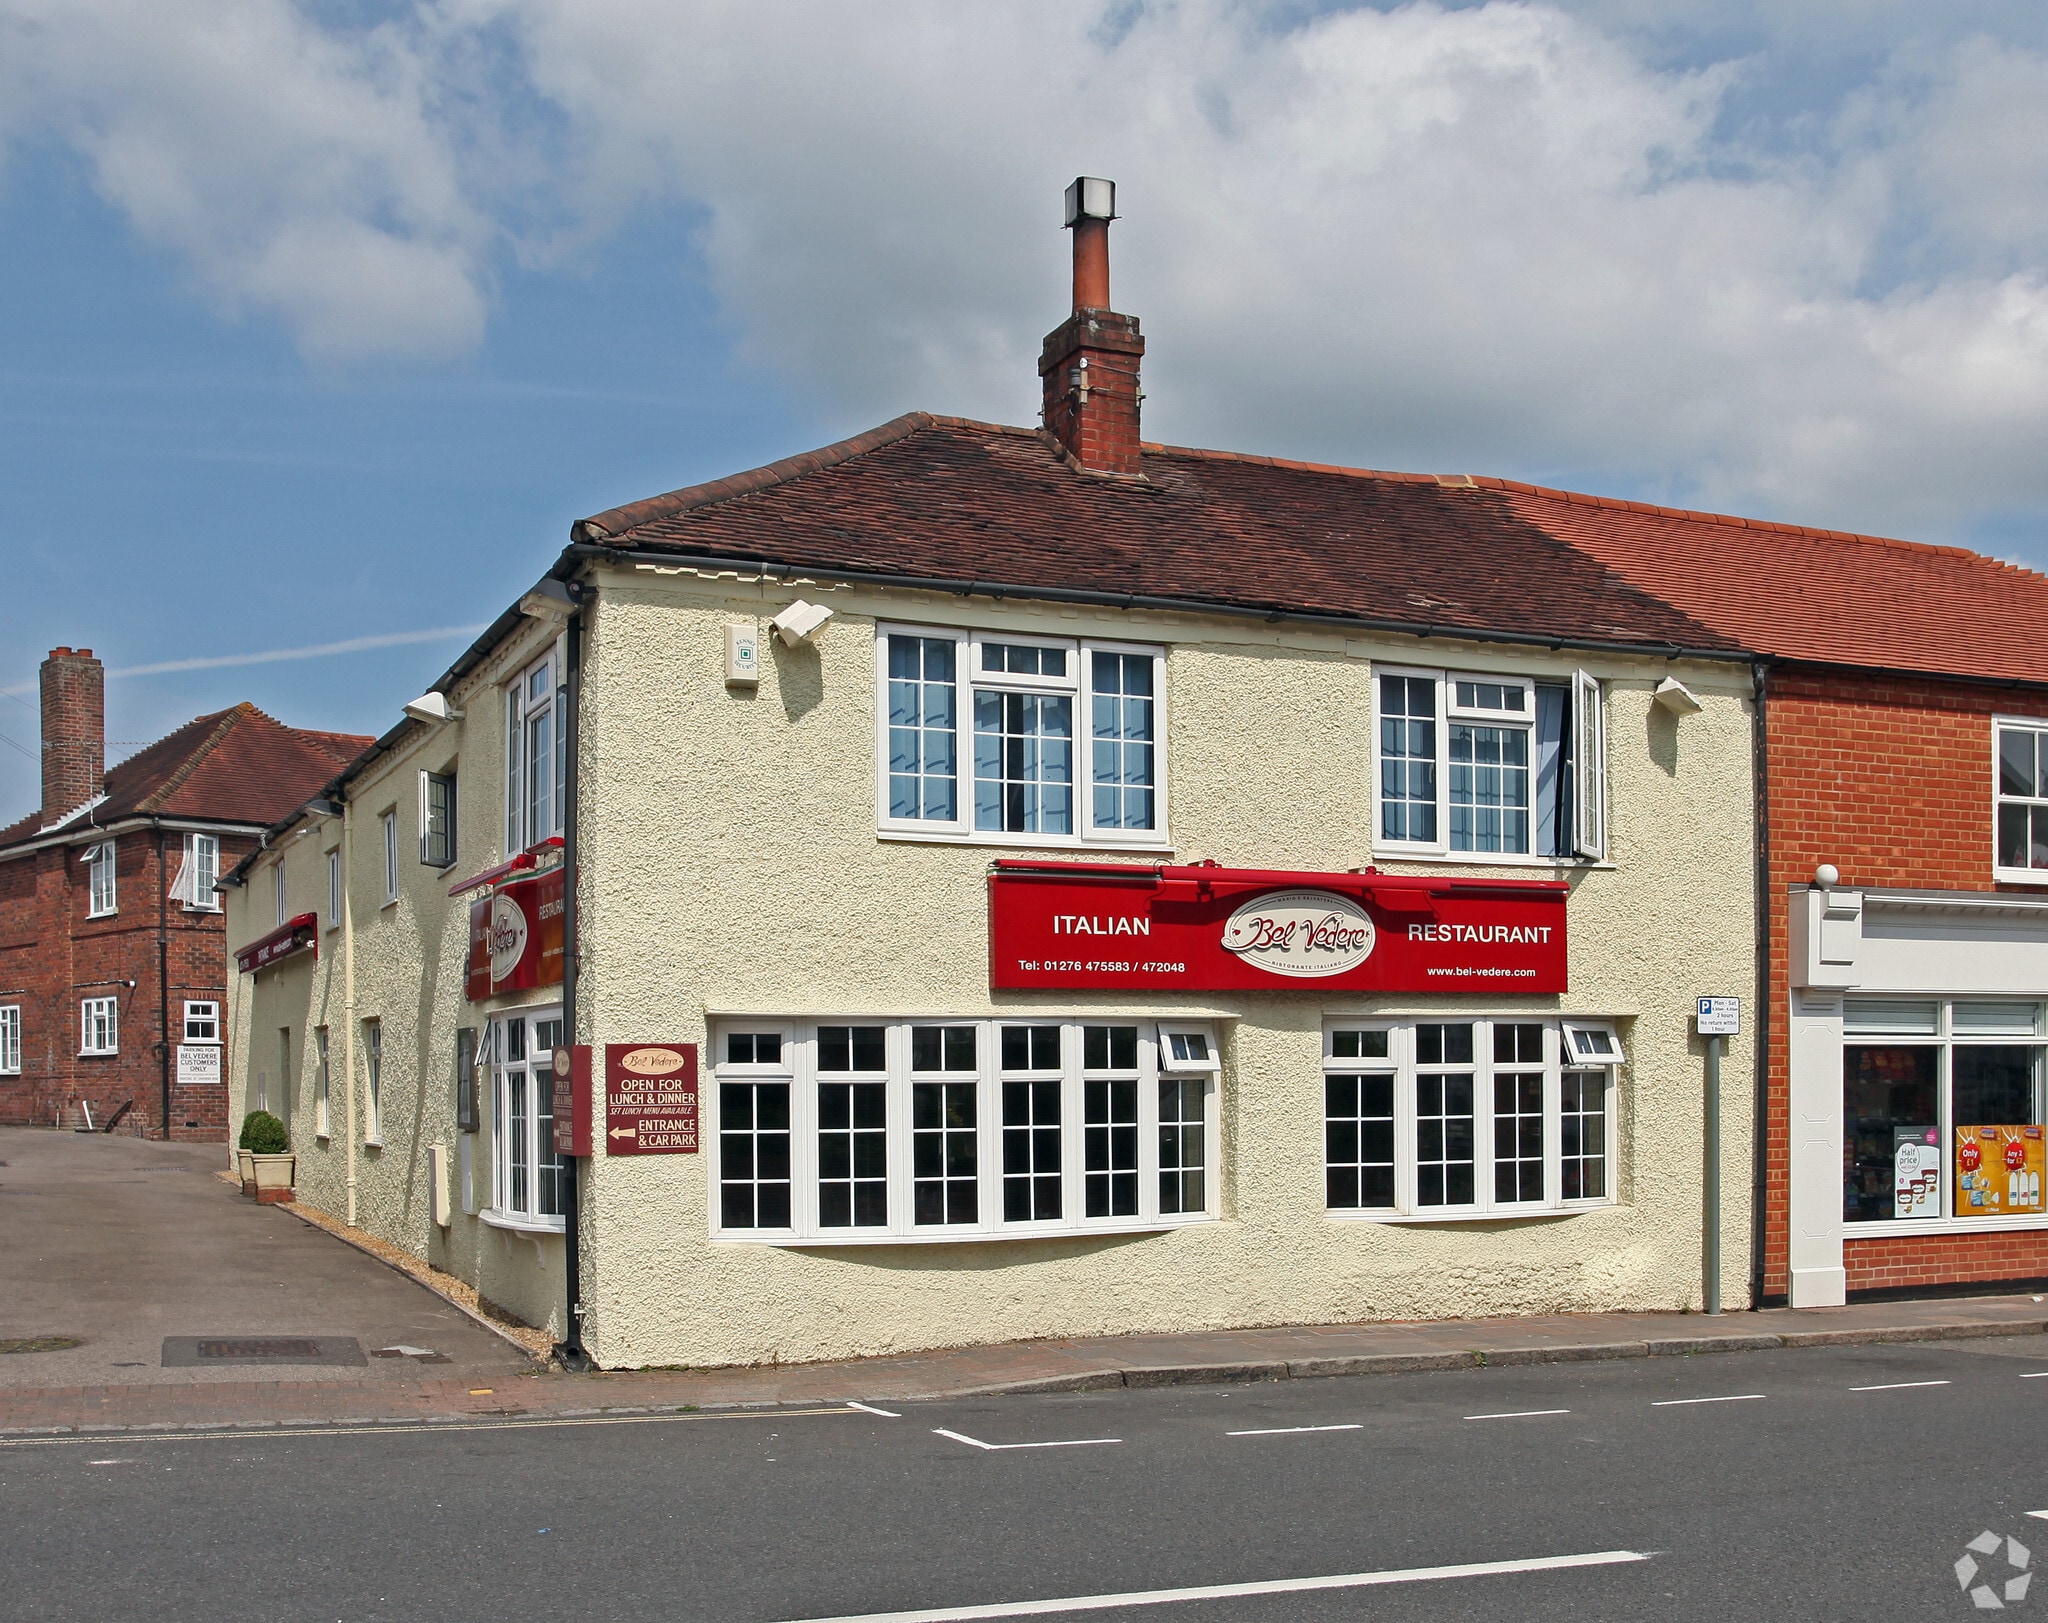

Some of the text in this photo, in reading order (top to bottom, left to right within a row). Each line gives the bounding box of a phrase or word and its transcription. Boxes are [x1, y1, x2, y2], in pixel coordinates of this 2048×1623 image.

[734, 660, 757, 669] SECURITY
[1053, 915, 1150, 936] ITALIAN
[1222, 911, 1366, 951] Bel Vedere
[1408, 923, 1552, 944] RESTAURANT
[1018, 960, 1185, 973] Tel: 01276 475583 / 472048
[1271, 961, 1342, 970] RISTORANTE ITALIANO
[1427, 966, 1536, 977] www.bel-vedere.com
[627, 1053, 678, 1067] Bel Vedere
[621, 1079, 683, 1091] OPEN FOR
[609, 1092, 696, 1105] LUNCH & DINNER
[609, 1107, 621, 1115] SET
[621, 1107, 643, 1115] LUNCH
[643, 1107, 660, 1115] MENU
[639, 1119, 695, 1131] ENTRANCE
[638, 1133, 697, 1146] & CAR PARK
[1901, 1148, 1916, 1156] Half
[1962, 1149, 1979, 1159] Only
[2007, 1149, 2023, 1158] Any 2
[1899, 1156, 1918, 1165] price
[1966, 1158, 1974, 1166] £1
